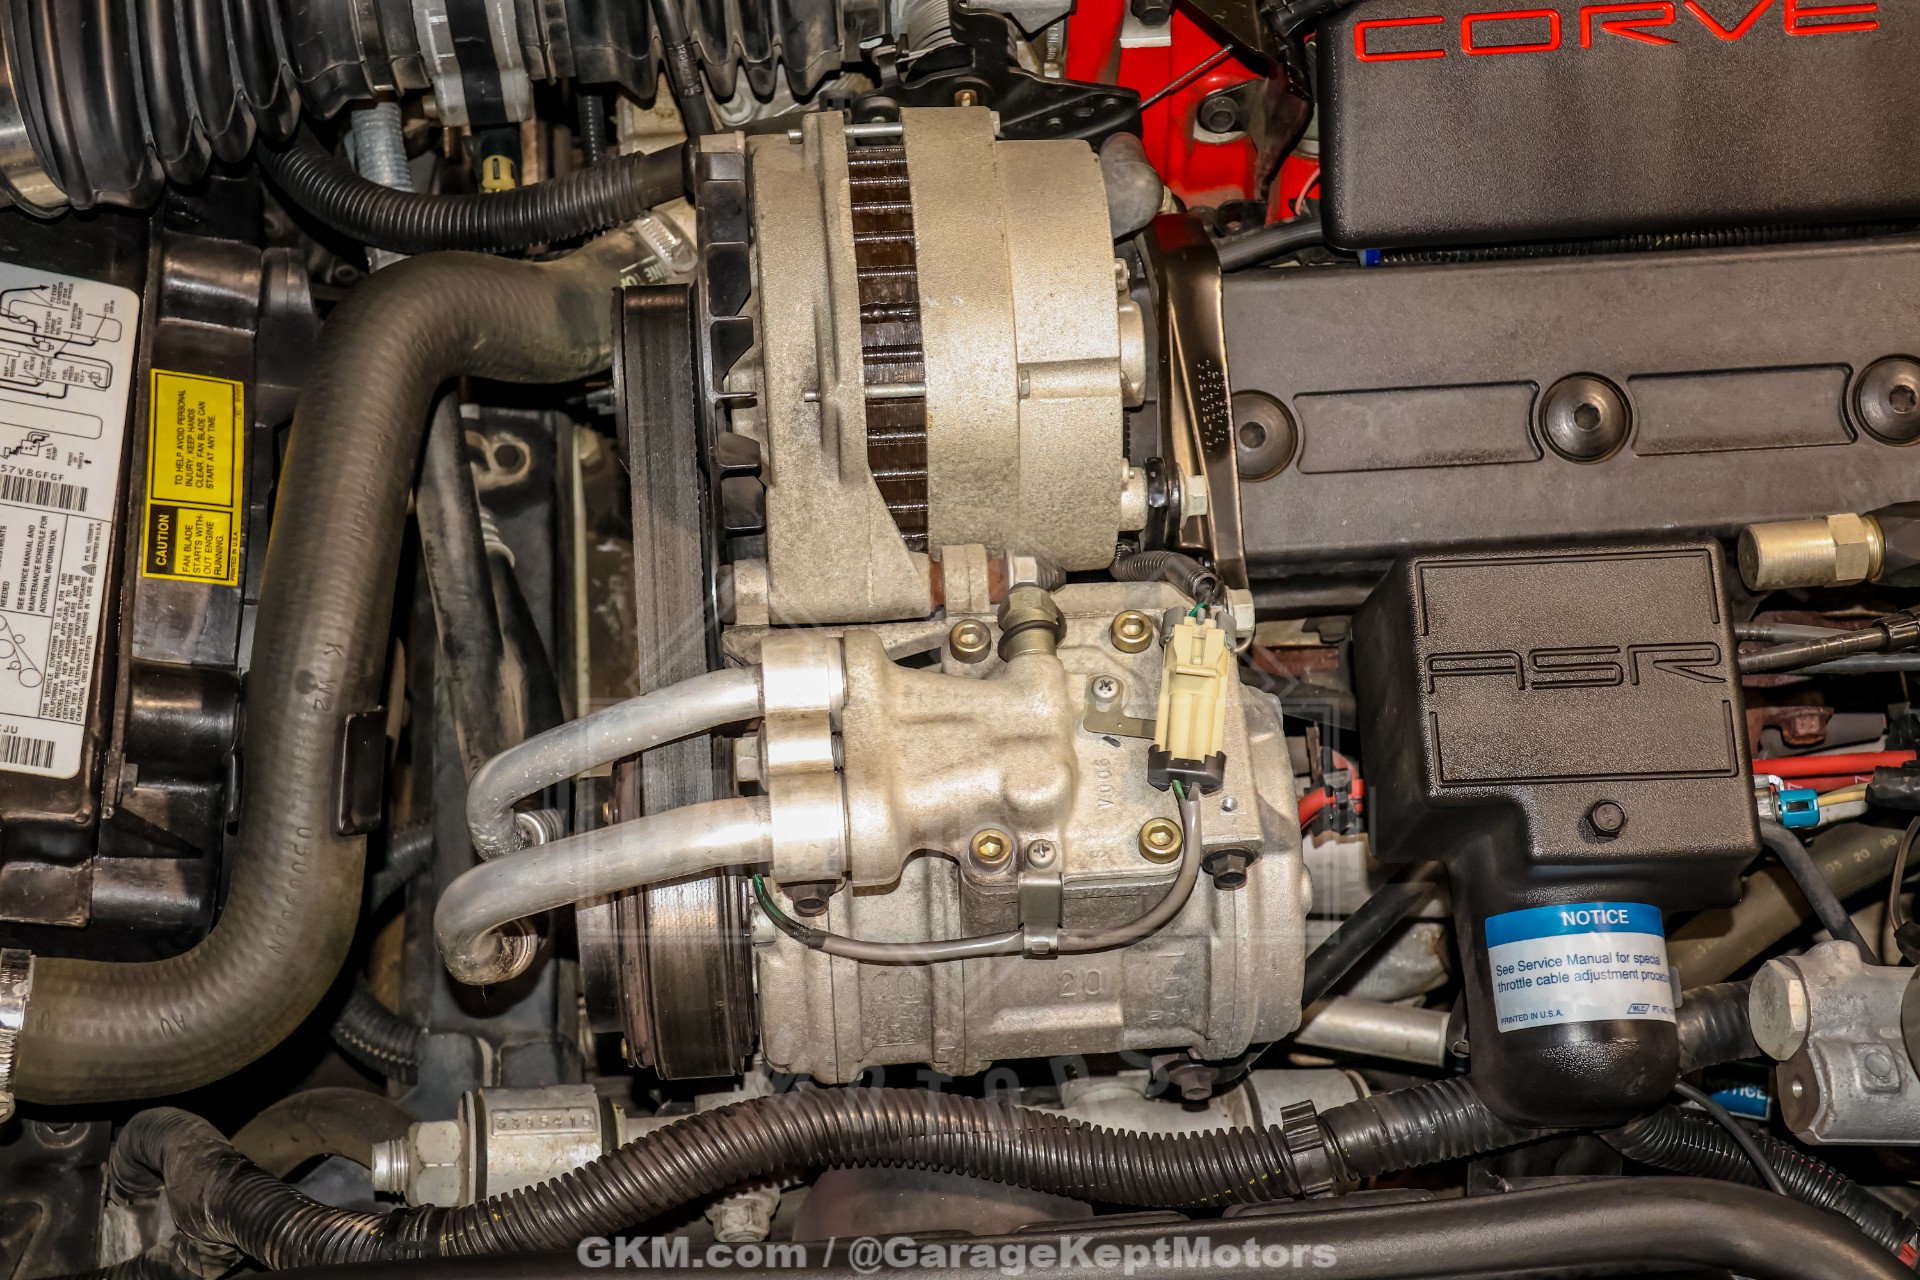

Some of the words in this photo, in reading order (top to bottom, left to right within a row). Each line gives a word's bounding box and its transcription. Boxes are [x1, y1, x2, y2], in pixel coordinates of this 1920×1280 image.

[187, 409, 195, 432] HANDS
[208, 415, 216, 432] TIME.
[207, 436, 215, 450] ANY
[207, 452, 214, 461] AT
[176, 453, 184, 472] HELP
[206, 464, 214, 489] START
[175, 475, 183, 485] TO
[27, 525, 35, 538] AND
[40, 516, 48, 529] FOR
[196, 514, 204, 537] WITH-
[35, 531, 46, 564] SCHEDULE
[45, 529, 57, 573] INFORMATION.
[156, 515, 169, 565] CAUTION
[184, 525, 193, 552] BLADE
[205, 522, 214, 553] ENGINE
[23, 540, 33, 567] MANUAL
[183, 555, 191, 572] FAN
[193, 540, 202, 573] STARTS
[204, 557, 212, 574] OUT
[214, 534, 223, 575] RUNNING.
[0, 581, 9, 607] NEEDED
[19, 568, 29, 596] SERVICE
[28, 566, 40, 611] MAINTENANCE
[40, 575, 51, 613] ADDITIONAL
[60, 601, 70, 636] APPLICABLE
[79, 611, 89, 645] STANDARDS
[53, 640, 65, 679] REGULATIONS
[56, 680, 65, 718] MODEL-YEAR
[64, 623, 74, 656] PASSENGER
[69, 602, 77, 617] CARS
[63, 690, 72, 719] CERTIFIED
[70, 639, 79, 664] PRIMARY
[78, 577, 87, 610] STANDARDS
[84, 635, 93, 664] CERTIFIED.
[44, 673, 53, 697] VEHICLE
[49, 635, 59, 668] CONFORMS
[74, 648, 85, 686] ALTERNATIVE
[1424, 641, 1727, 694] ASR
[49, 683, 59, 717] CALIFORNIA
[1562, 909, 1629, 926] NOTICE
[1496, 965, 1514, 976] See
[1517, 957, 1562, 972] Service
[1567, 952, 1612, 966] Manual
[1616, 952, 1630, 963] for
[1057, 968, 1103, 999] 20
[1498, 976, 1532, 993] throttle
[1536, 970, 1569, 986] cable
[1575, 969, 1638, 985] adjustment
[1501, 1014, 1528, 1025] PRINTED
